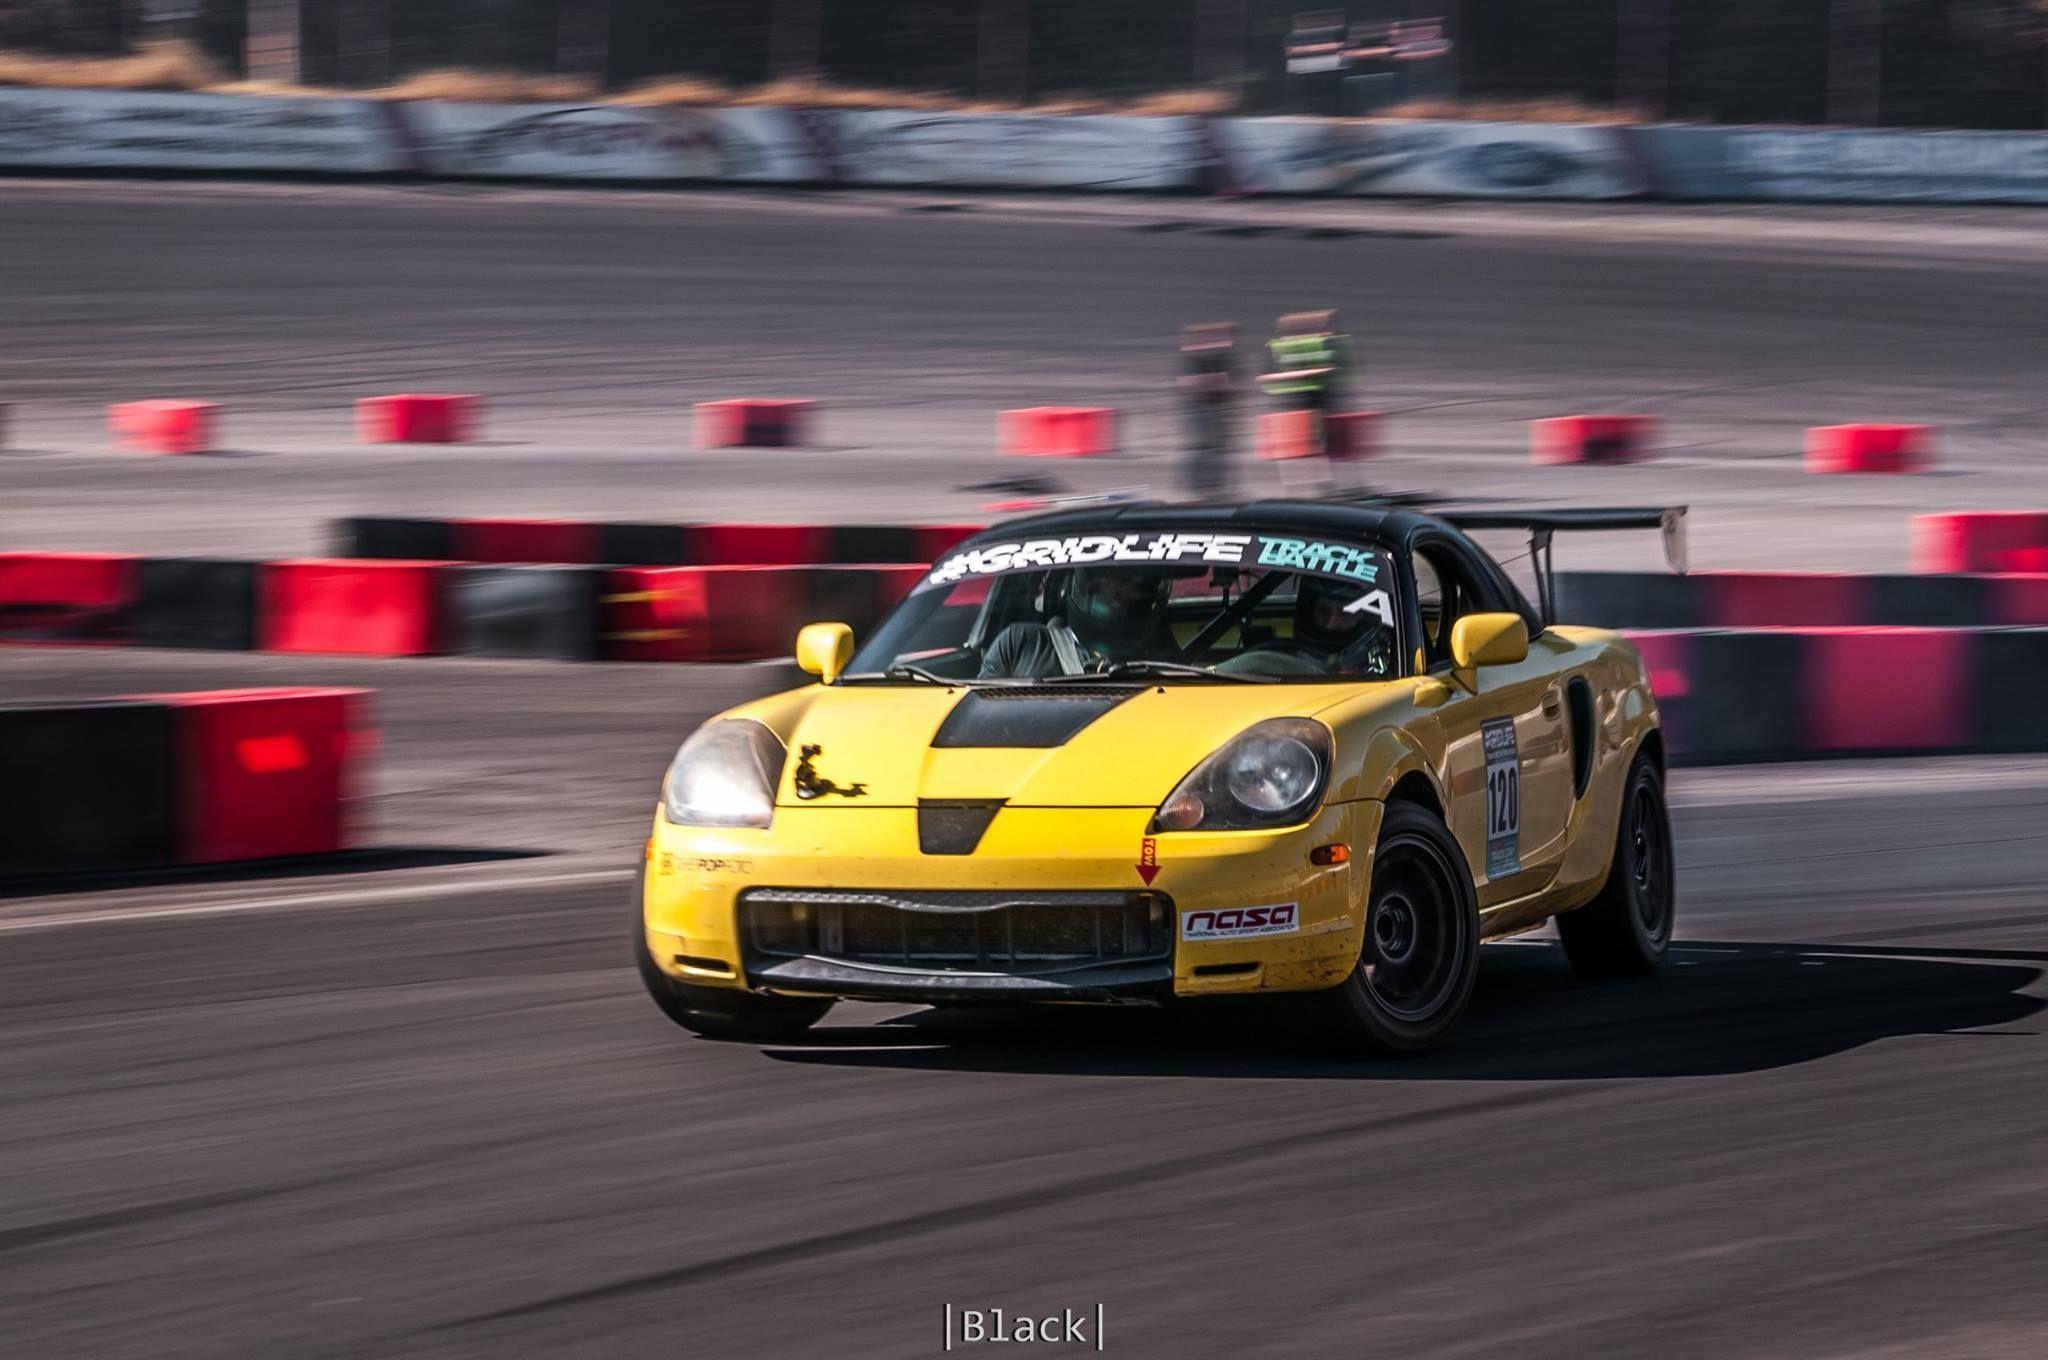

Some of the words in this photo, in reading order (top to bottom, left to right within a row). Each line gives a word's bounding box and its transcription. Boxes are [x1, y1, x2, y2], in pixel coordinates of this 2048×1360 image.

[930, 534, 1252, 585] #GRIDLIFE
[1258, 536, 1375, 565] TRACK
[1258, 550, 1379, 584] BATTLE
[1343, 589, 1395, 628] A
[1489, 767, 1518, 834] 120
[1143, 839, 1154, 866] TOW
